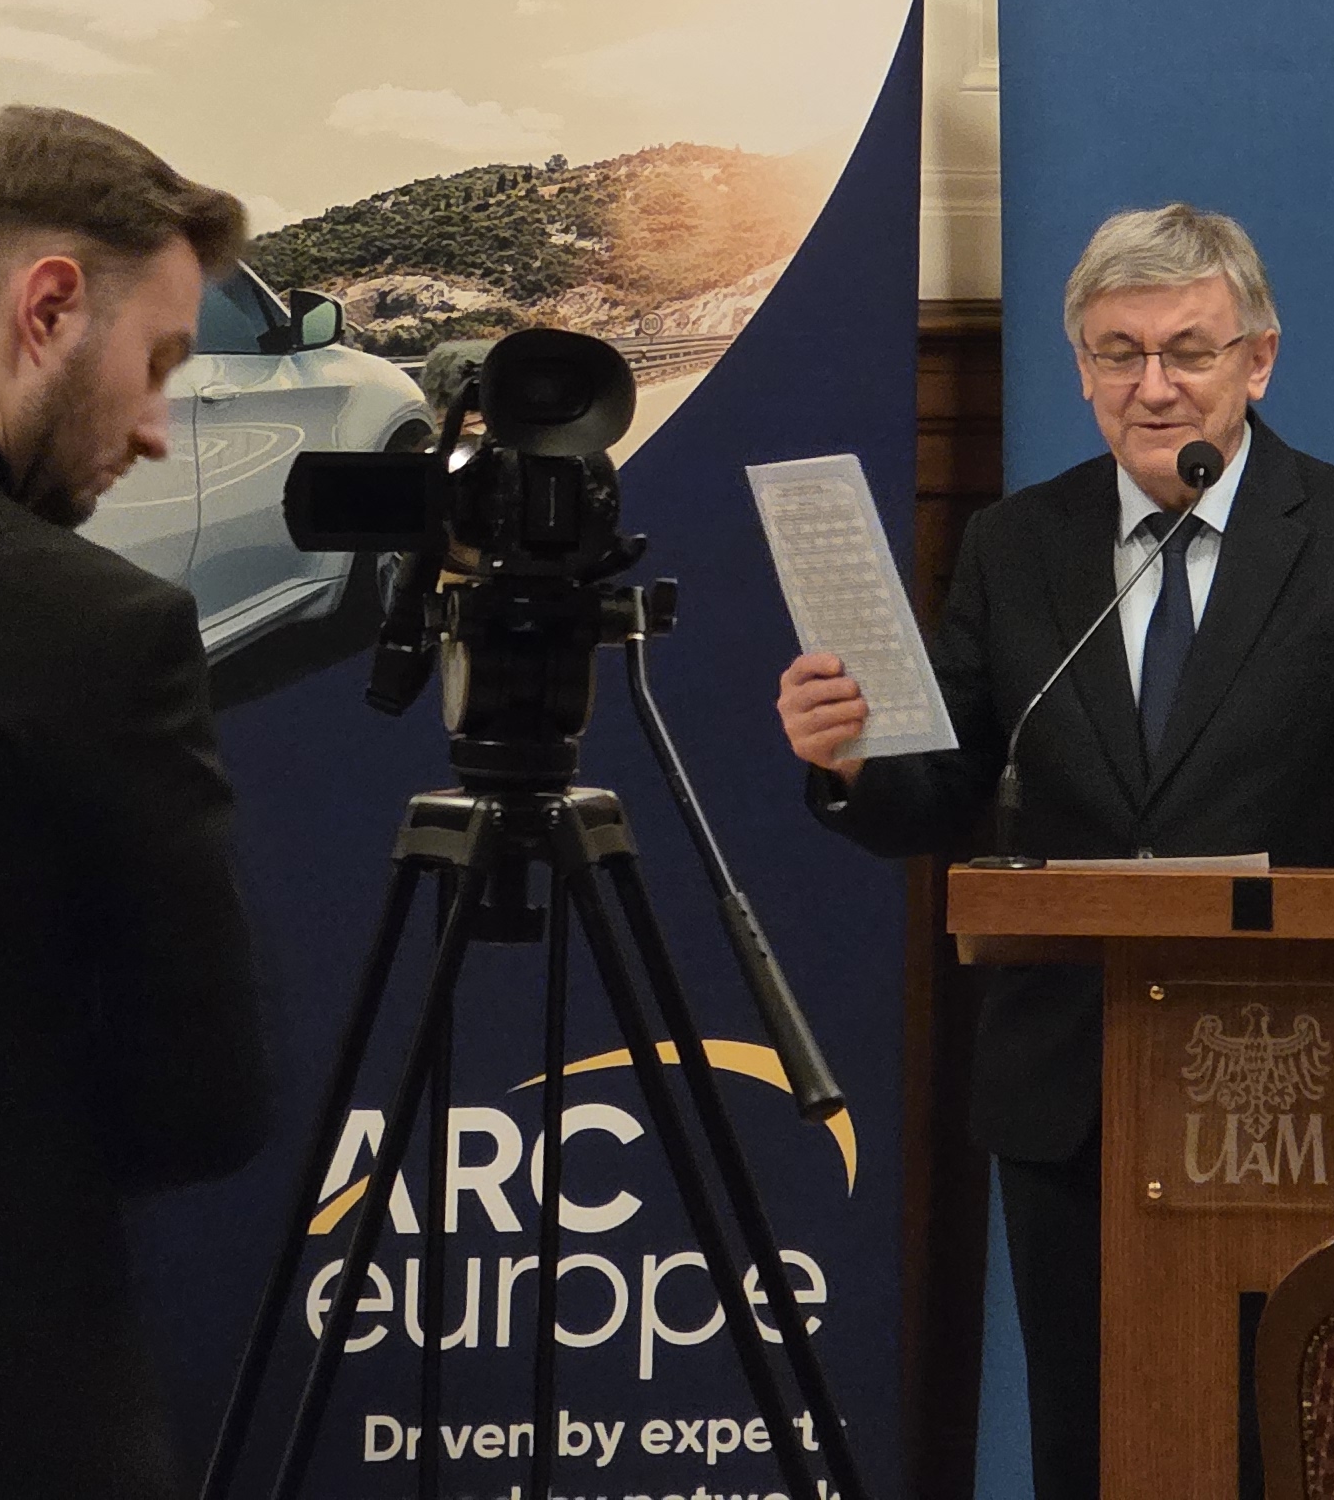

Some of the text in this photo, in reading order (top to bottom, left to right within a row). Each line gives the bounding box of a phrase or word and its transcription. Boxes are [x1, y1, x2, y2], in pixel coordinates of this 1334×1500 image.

[307, 1103, 645, 1236] ARC
[1183, 1112, 1329, 1186] UAM
[305, 1249, 828, 1381] europe
[363, 1410, 847, 1467] Drven by expet
